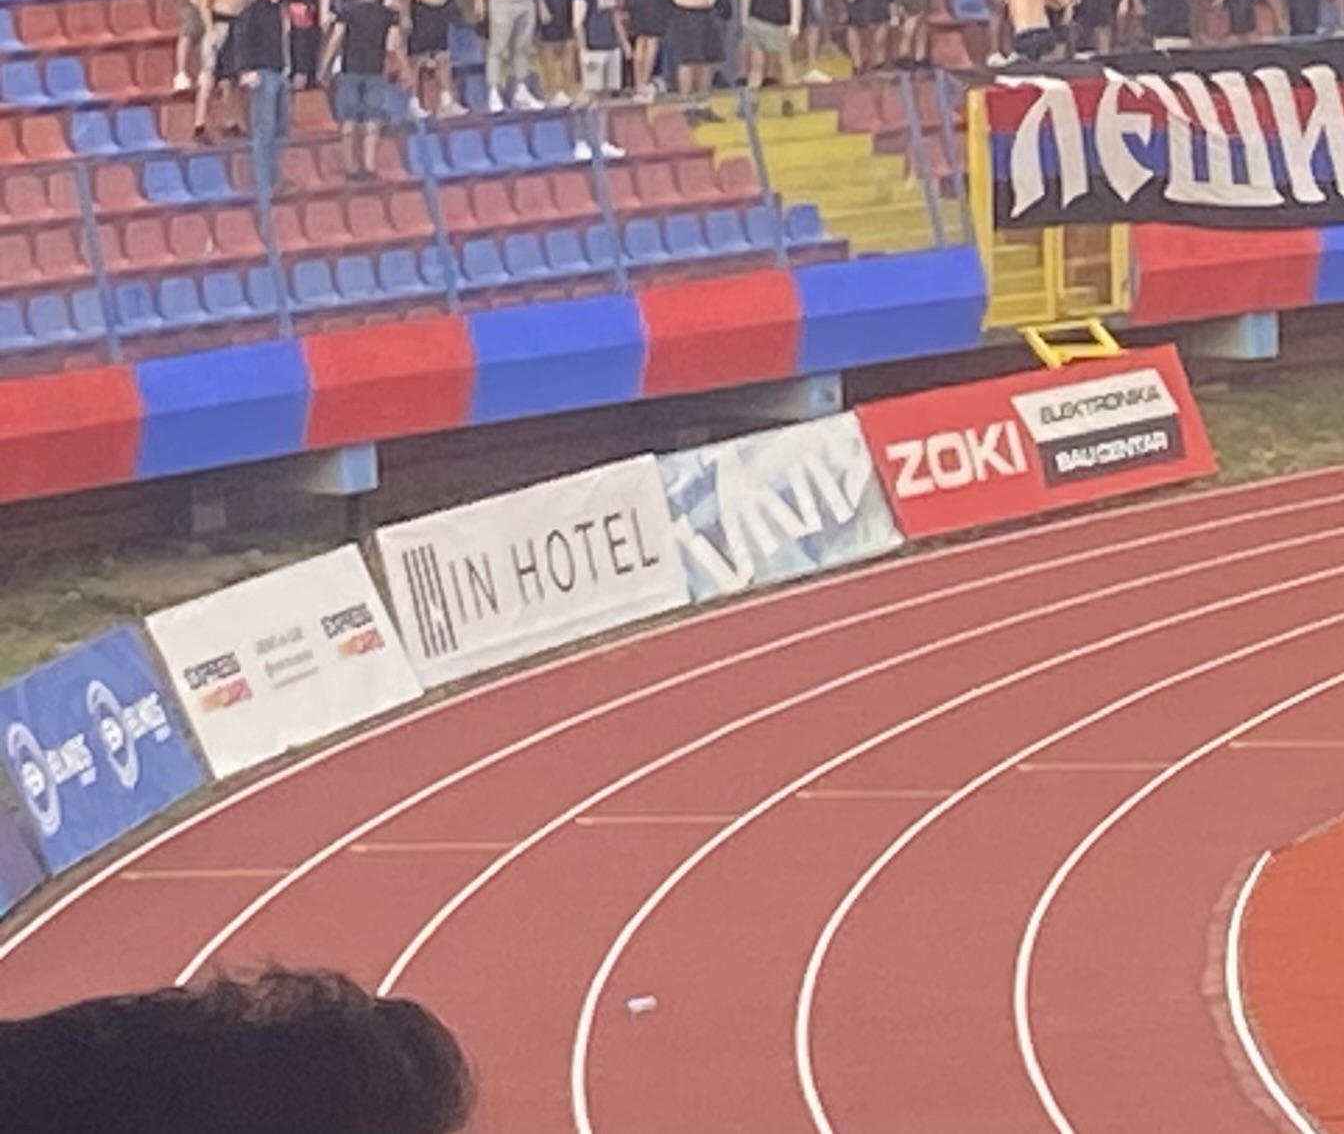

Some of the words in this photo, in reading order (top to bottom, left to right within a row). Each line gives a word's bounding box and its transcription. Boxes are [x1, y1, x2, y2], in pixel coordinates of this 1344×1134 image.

[1041, 384, 1162, 425] ELEKTRONIKA
[885, 419, 1029, 500] ZOKI
[450, 552, 500, 624] IN
[511, 507, 660, 606] HOTEL
